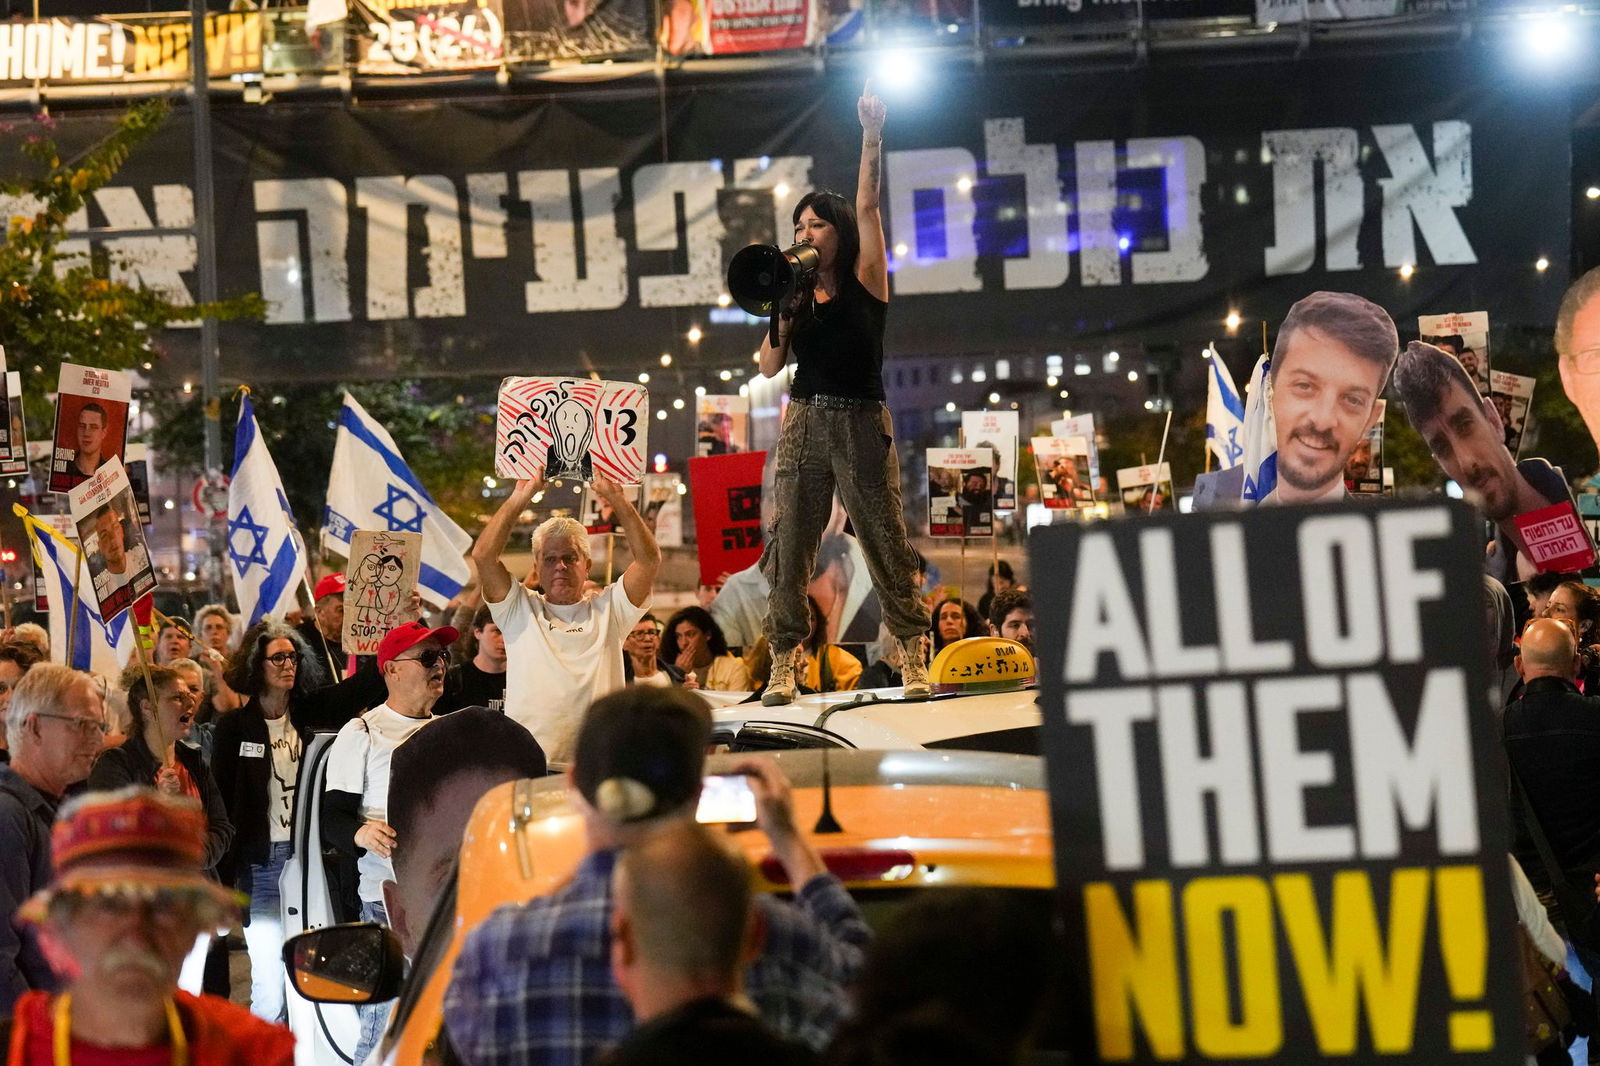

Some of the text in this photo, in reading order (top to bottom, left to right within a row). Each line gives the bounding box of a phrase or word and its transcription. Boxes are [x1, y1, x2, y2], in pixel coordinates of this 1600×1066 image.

[0, 21, 127, 80] HOME!
[886, 117, 1210, 296] כולם
[1261, 120, 1479, 276] את
[1064, 507, 1451, 684] ALL OF
[1557, 515, 1575, 531] עד
[350, 623, 377, 638] STOP
[1065, 667, 1481, 871] THEM
[1083, 865, 1495, 1061] NOW!
